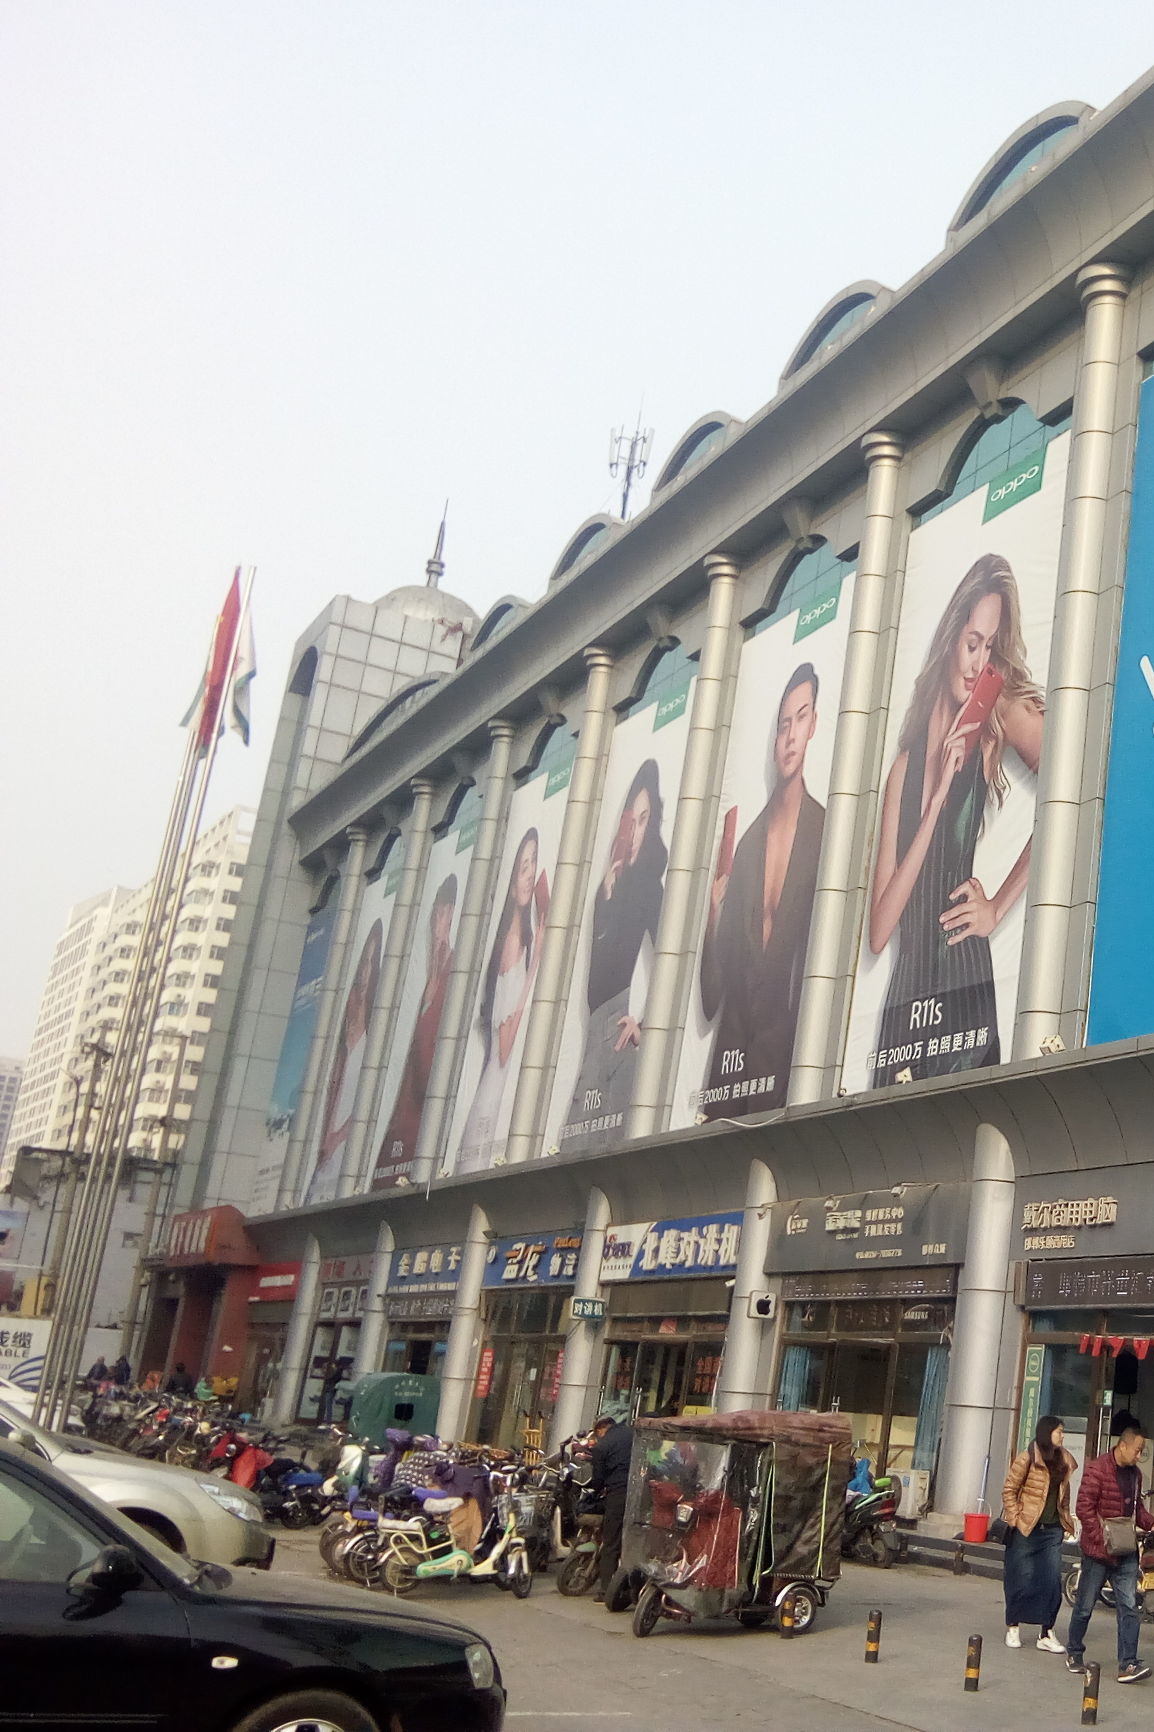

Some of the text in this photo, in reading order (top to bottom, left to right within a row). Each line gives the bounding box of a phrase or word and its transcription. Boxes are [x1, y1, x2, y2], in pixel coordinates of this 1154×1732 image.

[990, 465, 1040, 502] oppo
[909, 998, 943, 1031] R11s
[926, 1026, 989, 1057] 拍照更清晰
[721, 1049, 745, 1075] R11s
